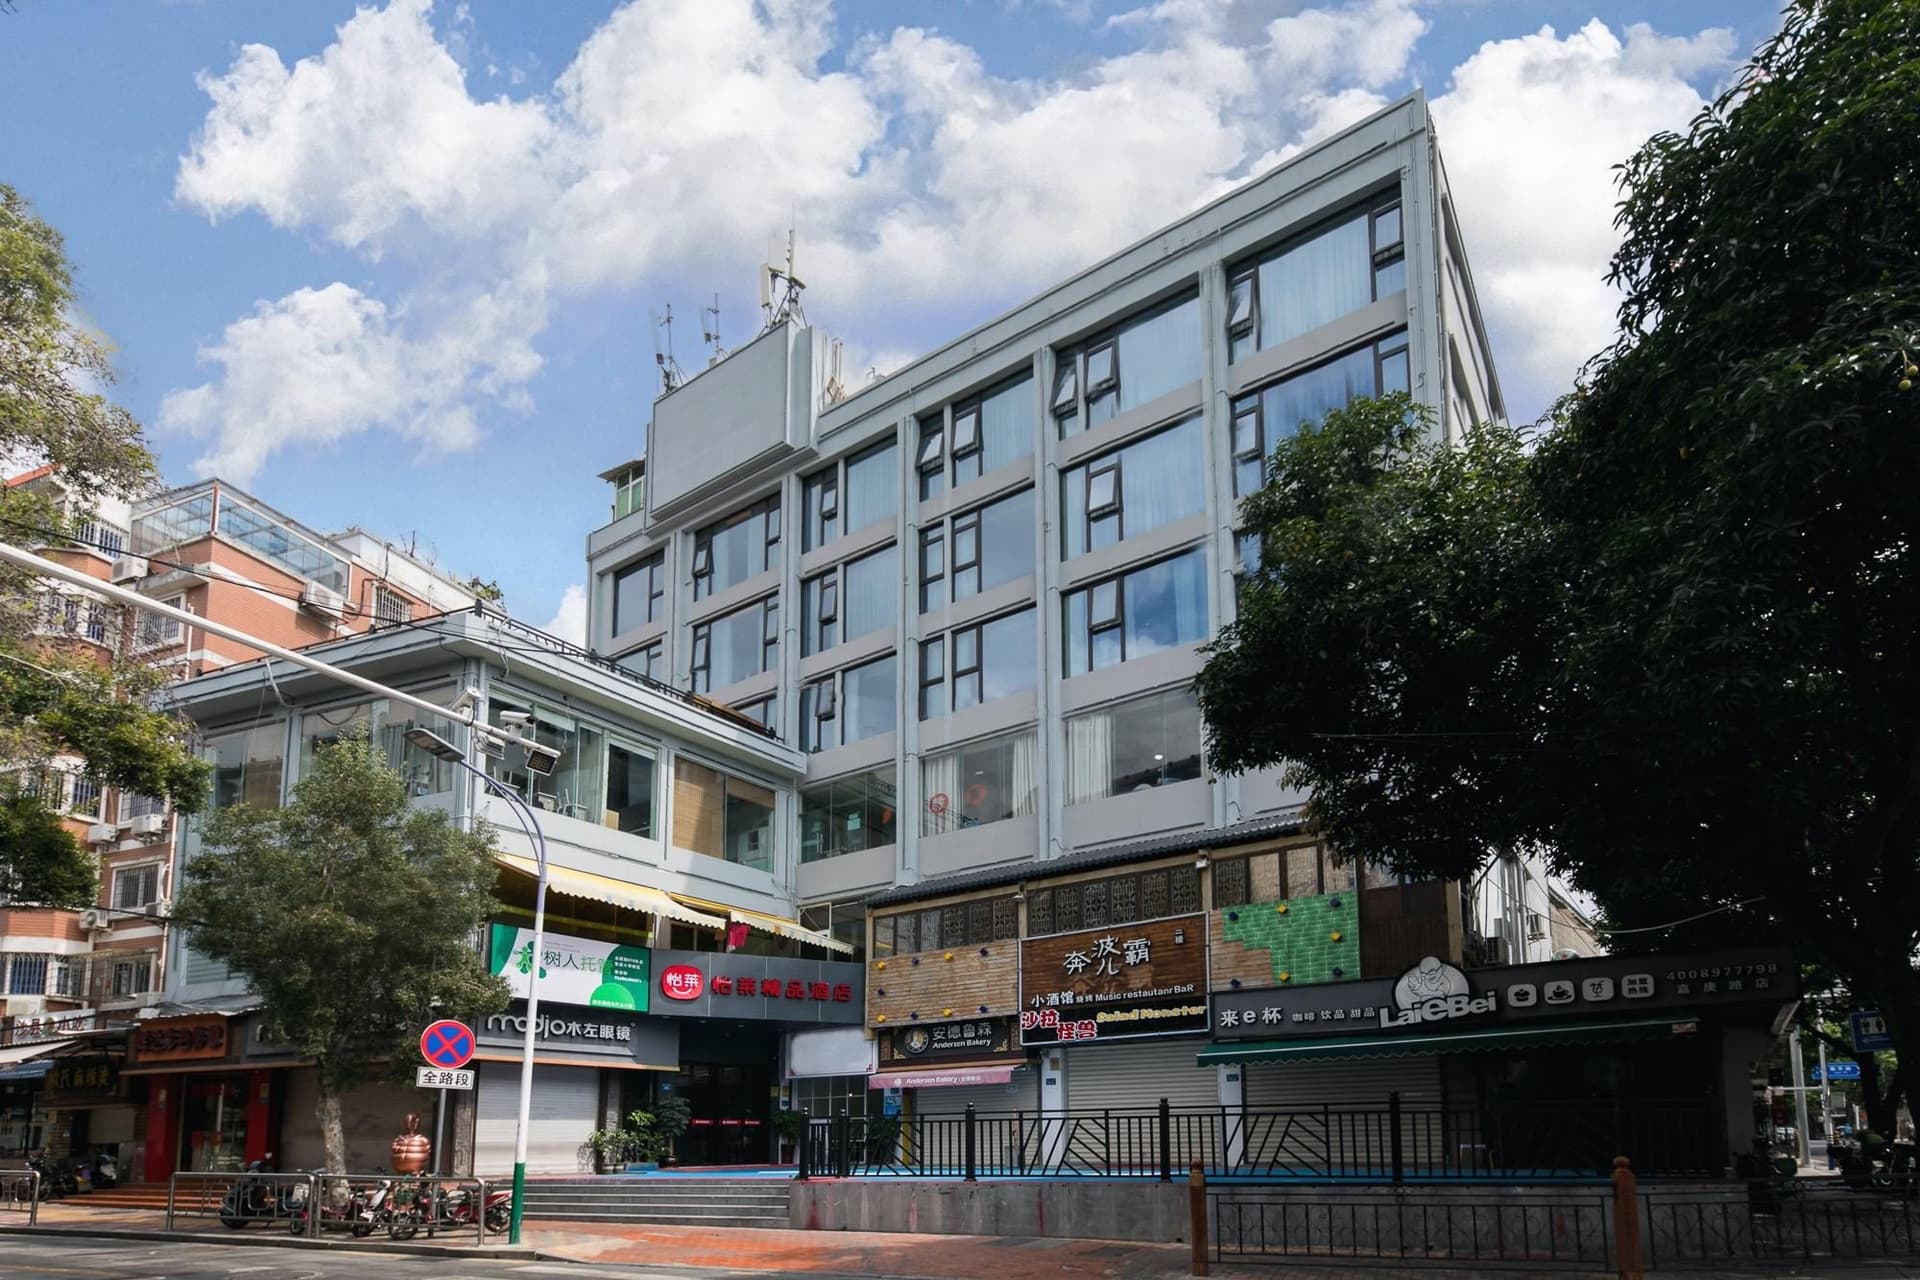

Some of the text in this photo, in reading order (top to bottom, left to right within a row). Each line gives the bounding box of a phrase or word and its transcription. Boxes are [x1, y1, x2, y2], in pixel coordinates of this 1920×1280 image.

[543, 949, 613, 975] 树人托管
[1062, 935, 1151, 976] 奔波儿霸
[666, 972, 699, 988] 怡莱
[1666, 963, 1777, 981] 4008977798
[712, 976, 851, 1002] 怡莱精品酒店
[1030, 991, 1074, 1007] 小酒馆
[1095, 993, 1121, 1002] Music
[1096, 1006, 1206, 1023] Salad Monster
[1220, 1007, 1376, 1027] 来e杯 咖啡 饮品 甜品
[1380, 991, 1496, 1028] LaieBei
[566, 1021, 630, 1041] 木左眼镜
[967, 1039, 991, 1048] Bakery
[423, 1071, 469, 1086] 全路段
